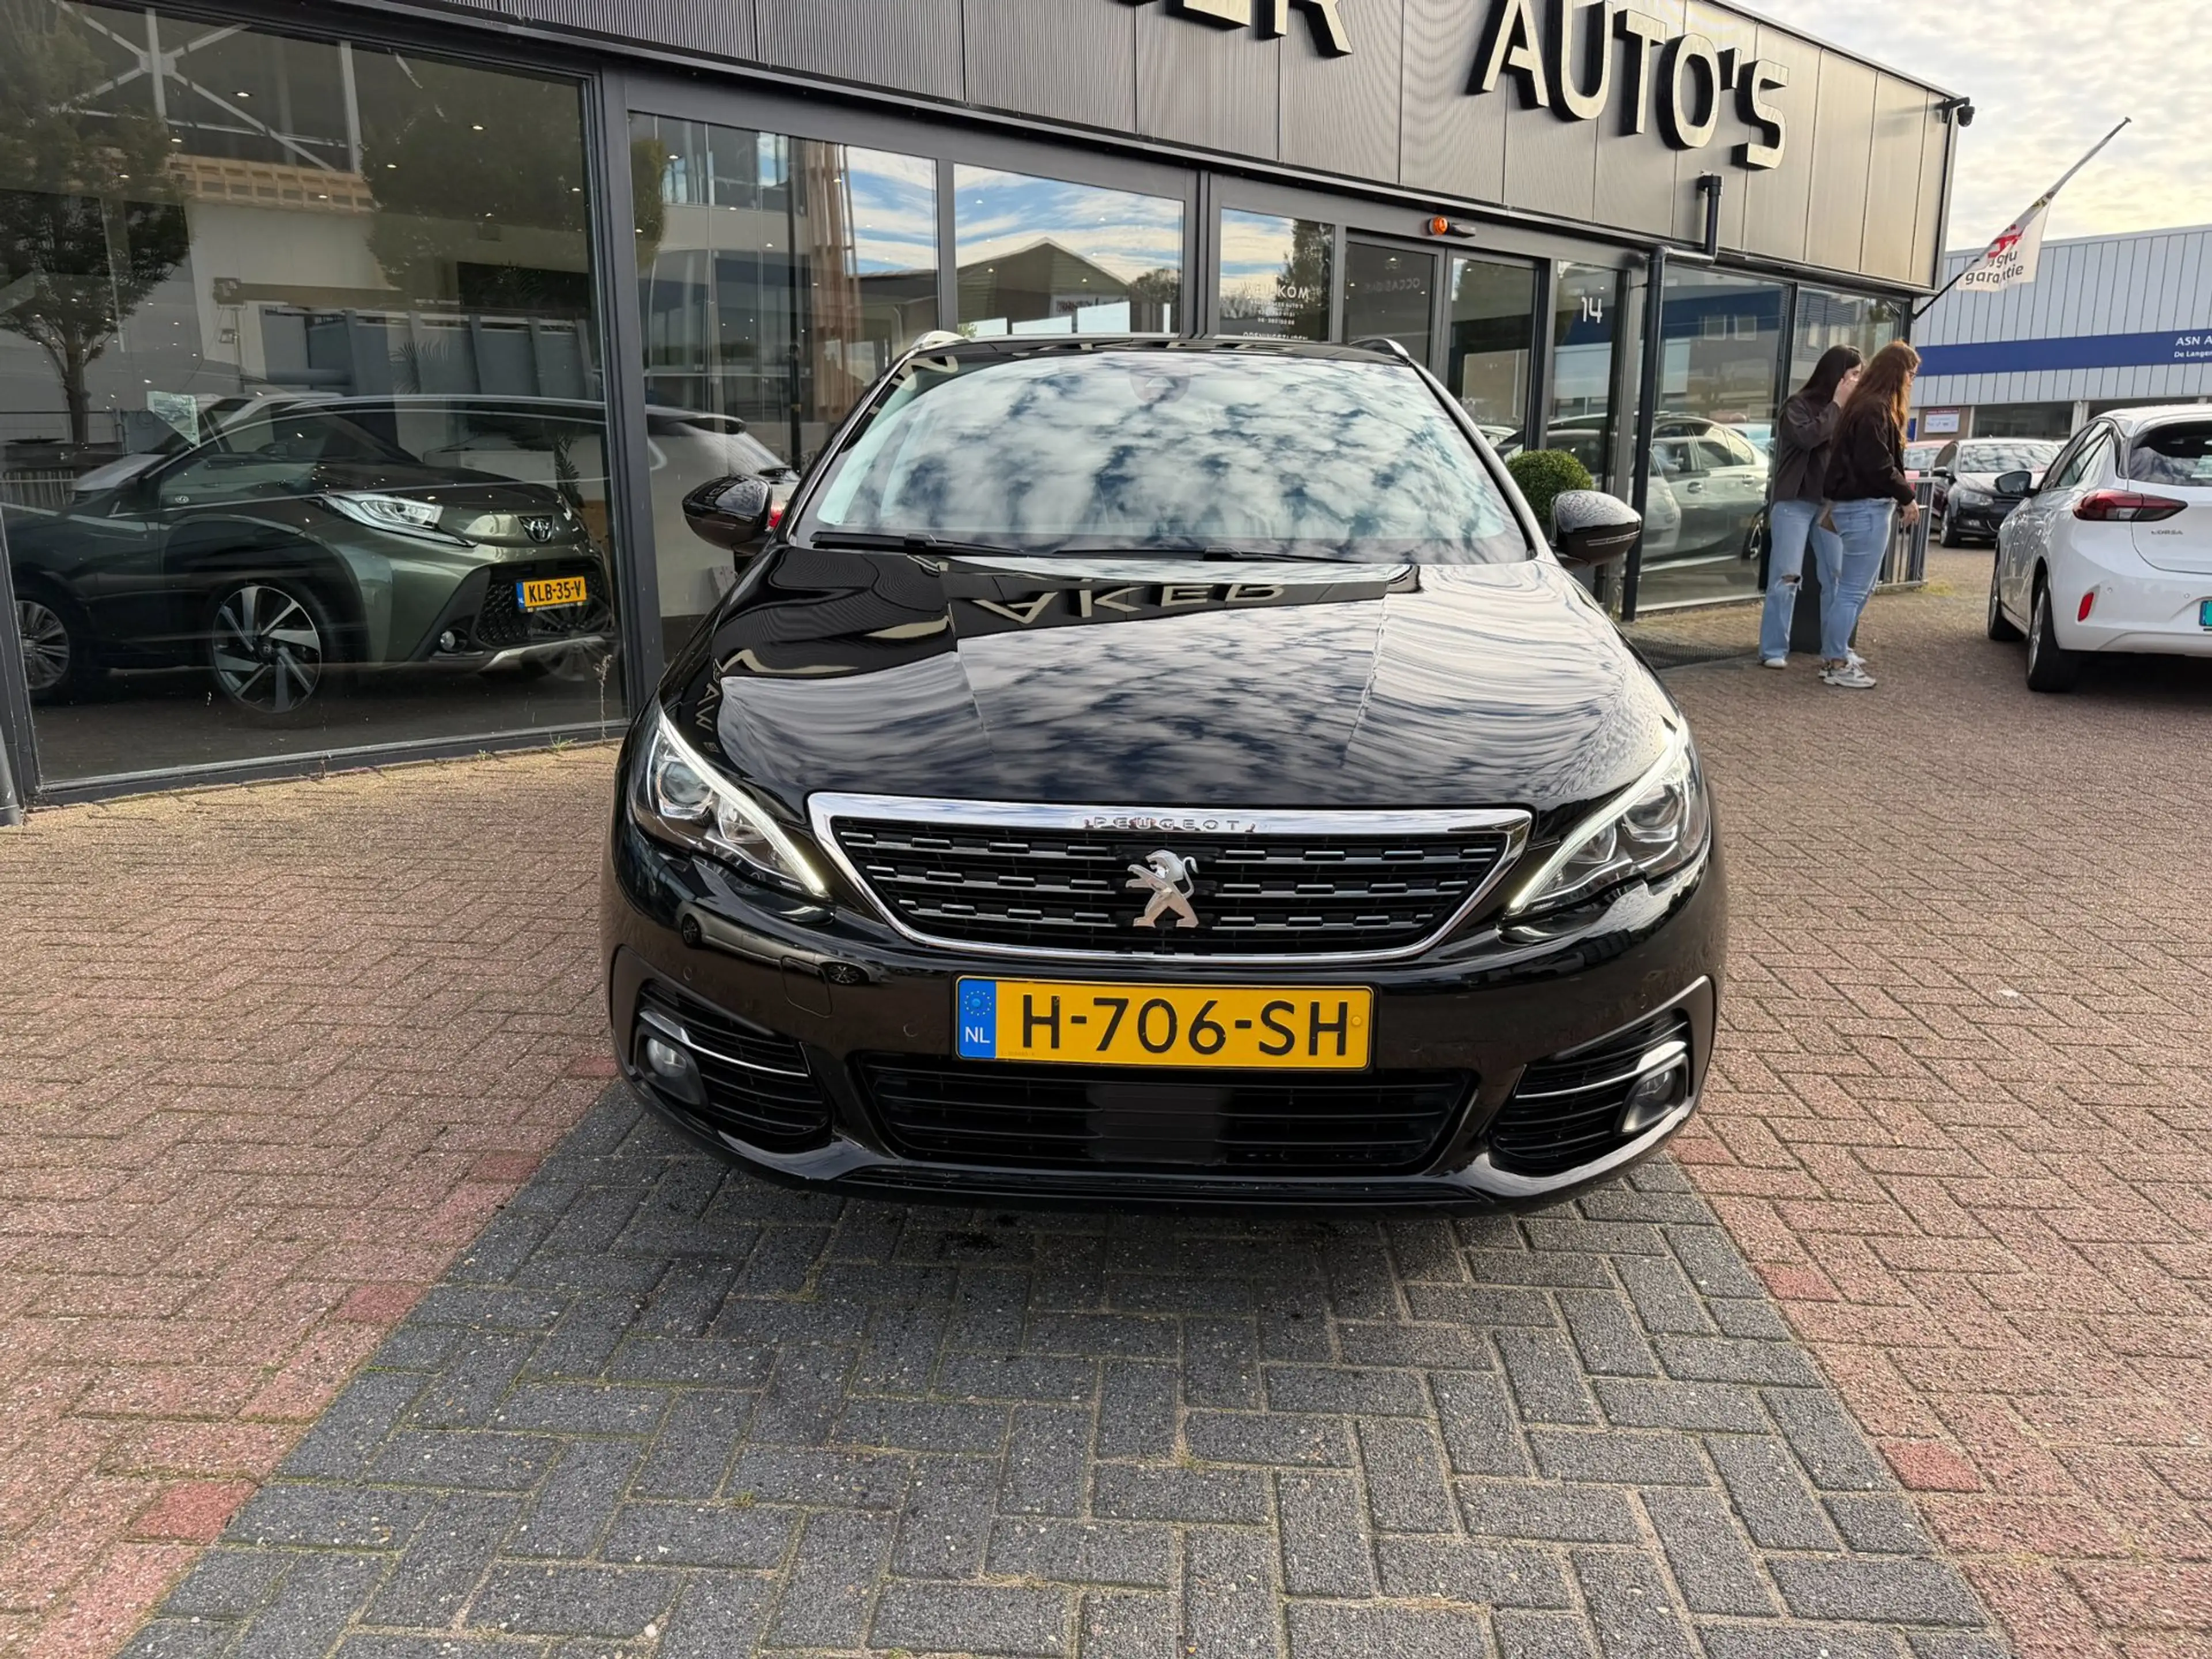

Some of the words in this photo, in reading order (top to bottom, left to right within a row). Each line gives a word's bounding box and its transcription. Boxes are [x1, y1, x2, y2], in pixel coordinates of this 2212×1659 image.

[1479, 0, 1789, 168] AUTO'S
[1581, 296, 1603, 323] 14
[2175, 336, 2200, 346] ASN
[528, 580, 581, 603] KLB-35-V
[1093, 816, 1240, 831] PEUGEOT
[965, 1026, 991, 1044] NL
[1022, 994, 1349, 1056] H-706-SH
